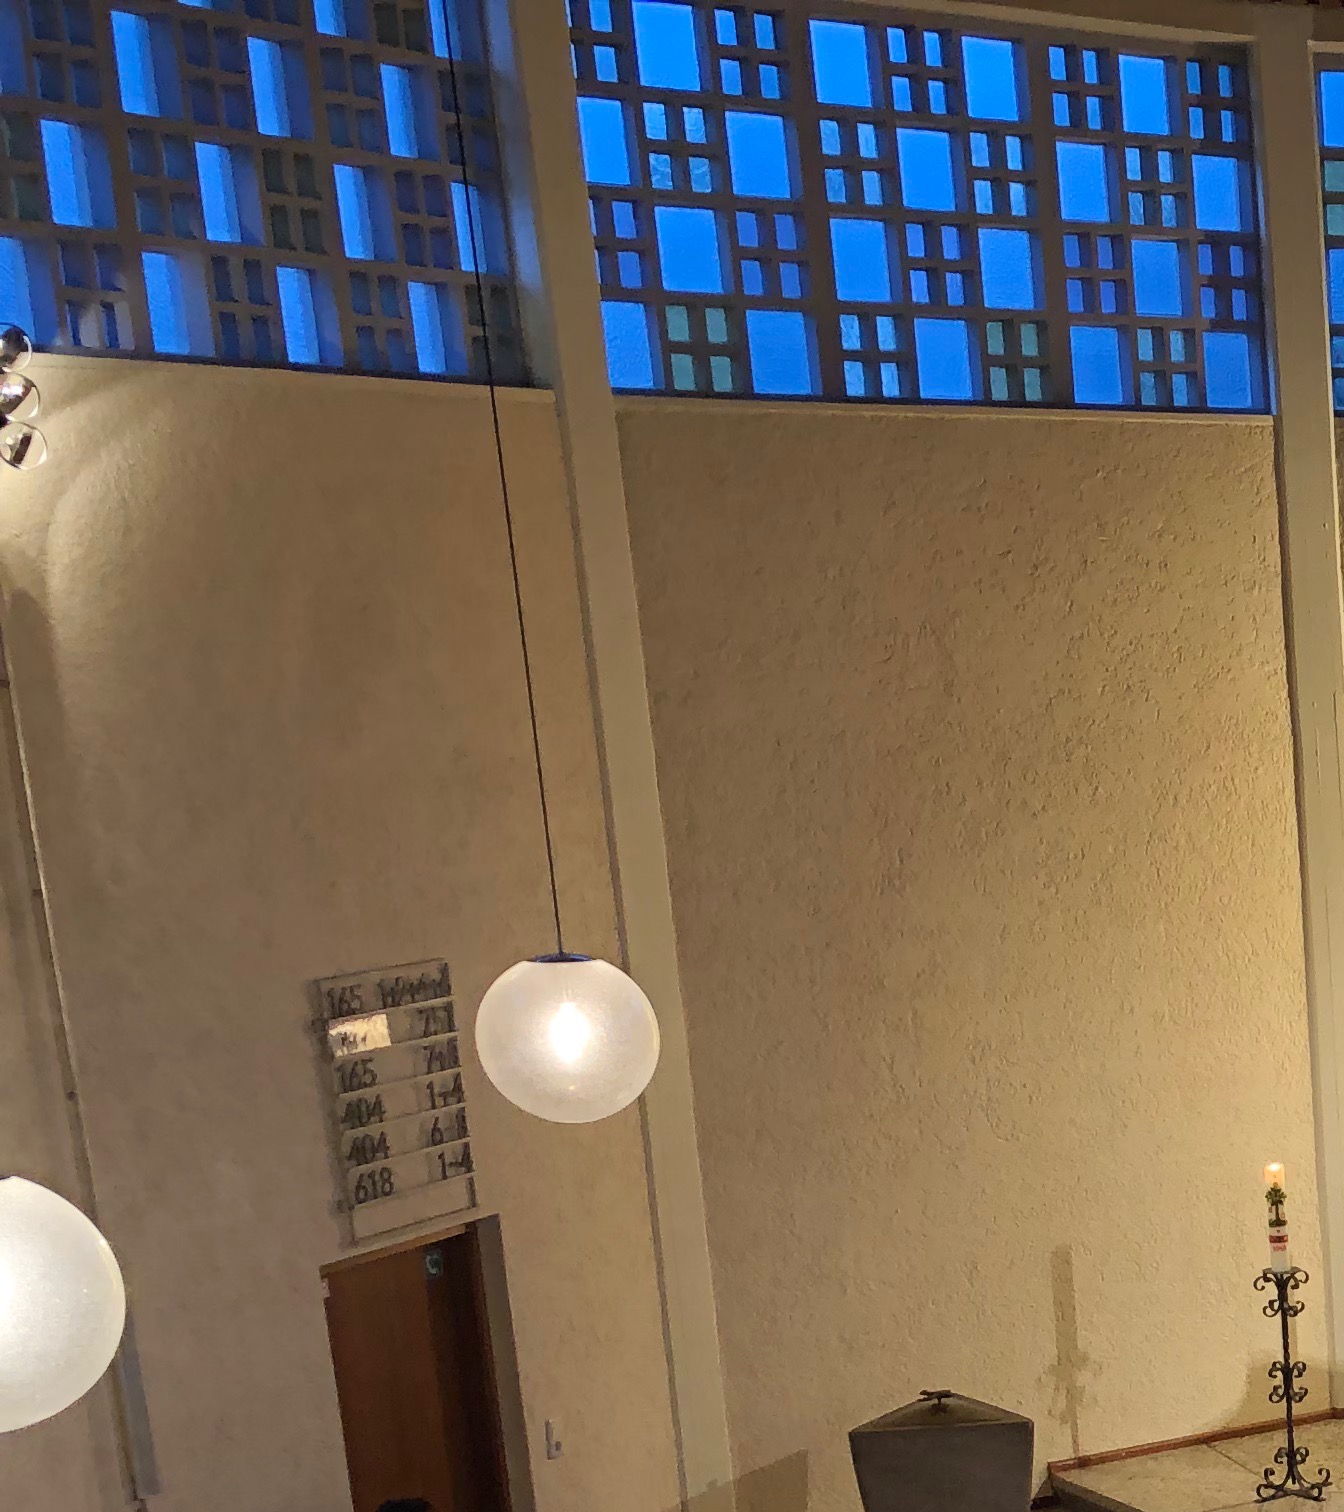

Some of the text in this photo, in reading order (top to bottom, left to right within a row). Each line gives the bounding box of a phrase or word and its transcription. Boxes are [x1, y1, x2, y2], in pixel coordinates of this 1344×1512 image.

[335, 1058, 377, 1093] 165
[347, 1131, 390, 1166] 404
[354, 1167, 394, 1204] 618
